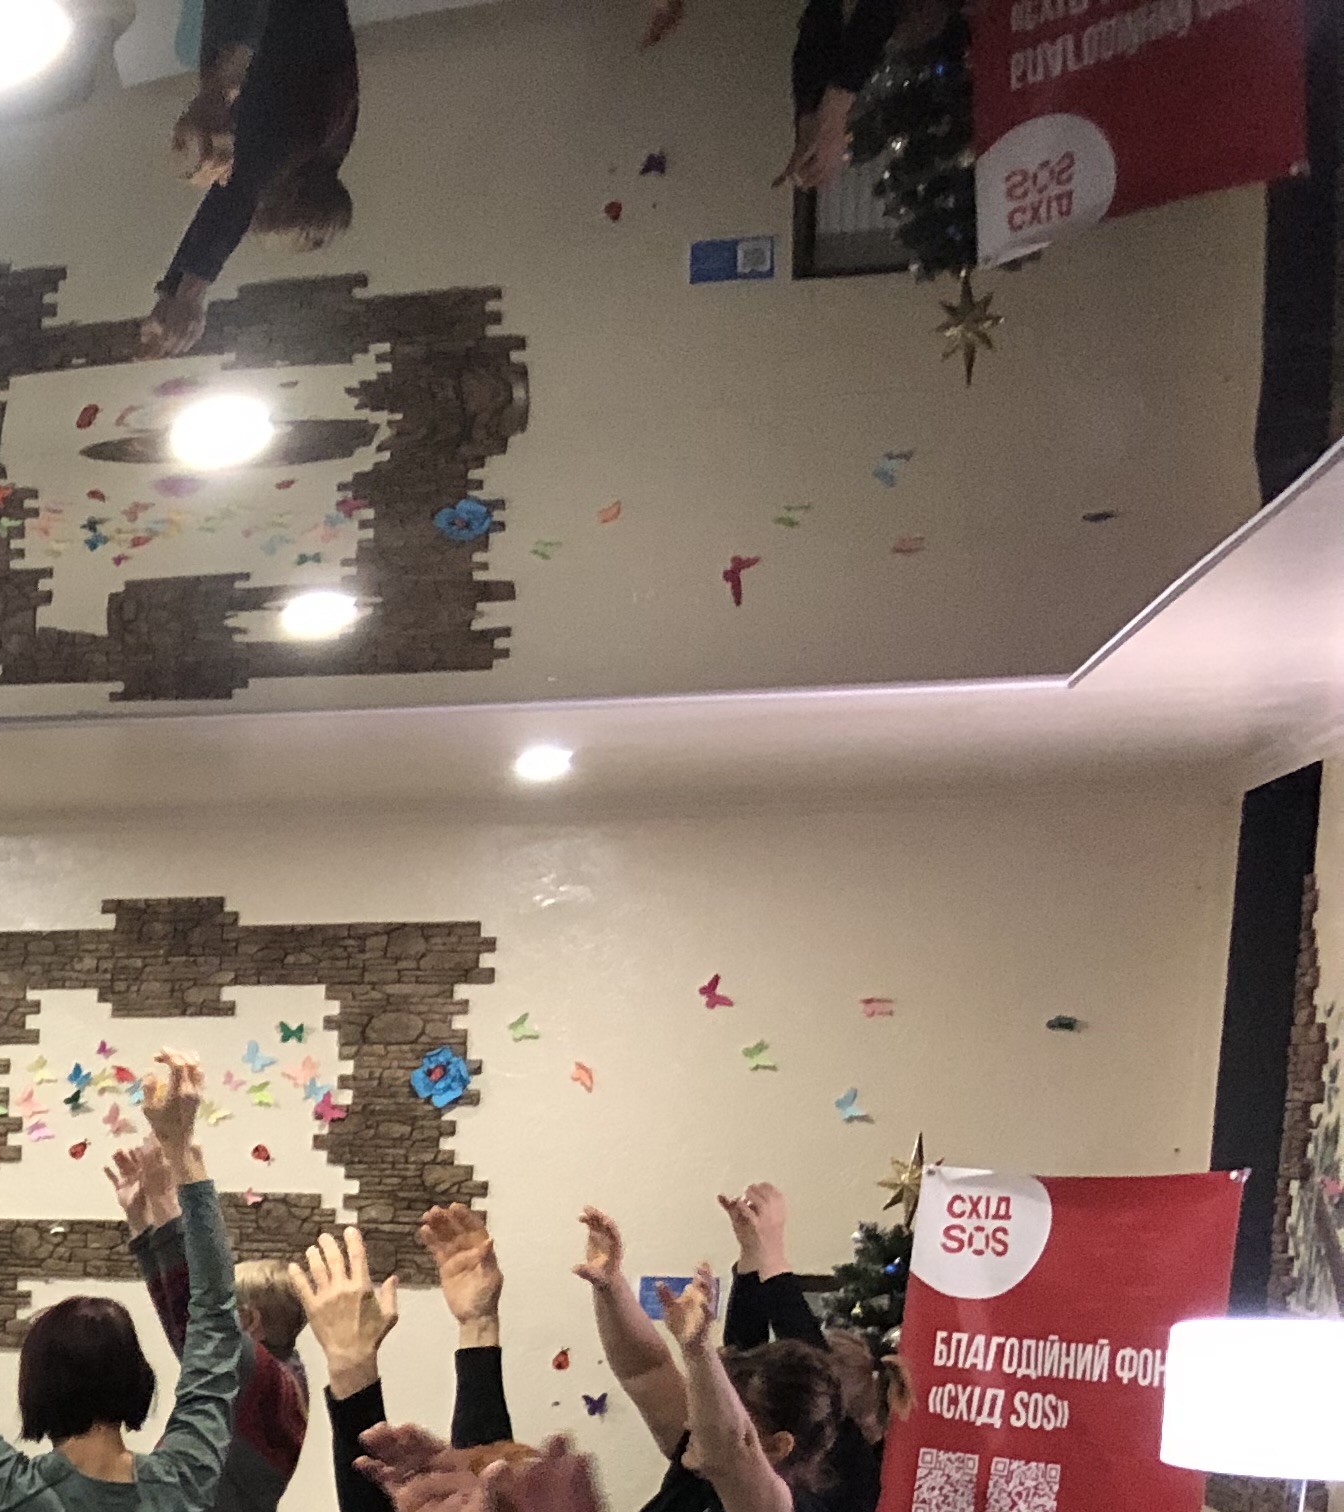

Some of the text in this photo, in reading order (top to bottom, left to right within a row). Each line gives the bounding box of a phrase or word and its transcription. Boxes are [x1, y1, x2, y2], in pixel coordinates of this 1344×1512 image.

[946, 1193, 1012, 1221] СХІД
[940, 1224, 1009, 1257] SOS
[933, 1330, 1167, 1388] БЛАГОДІЙНИЙ ФОН
[928, 1383, 1069, 1431] «СХІД SOS»
